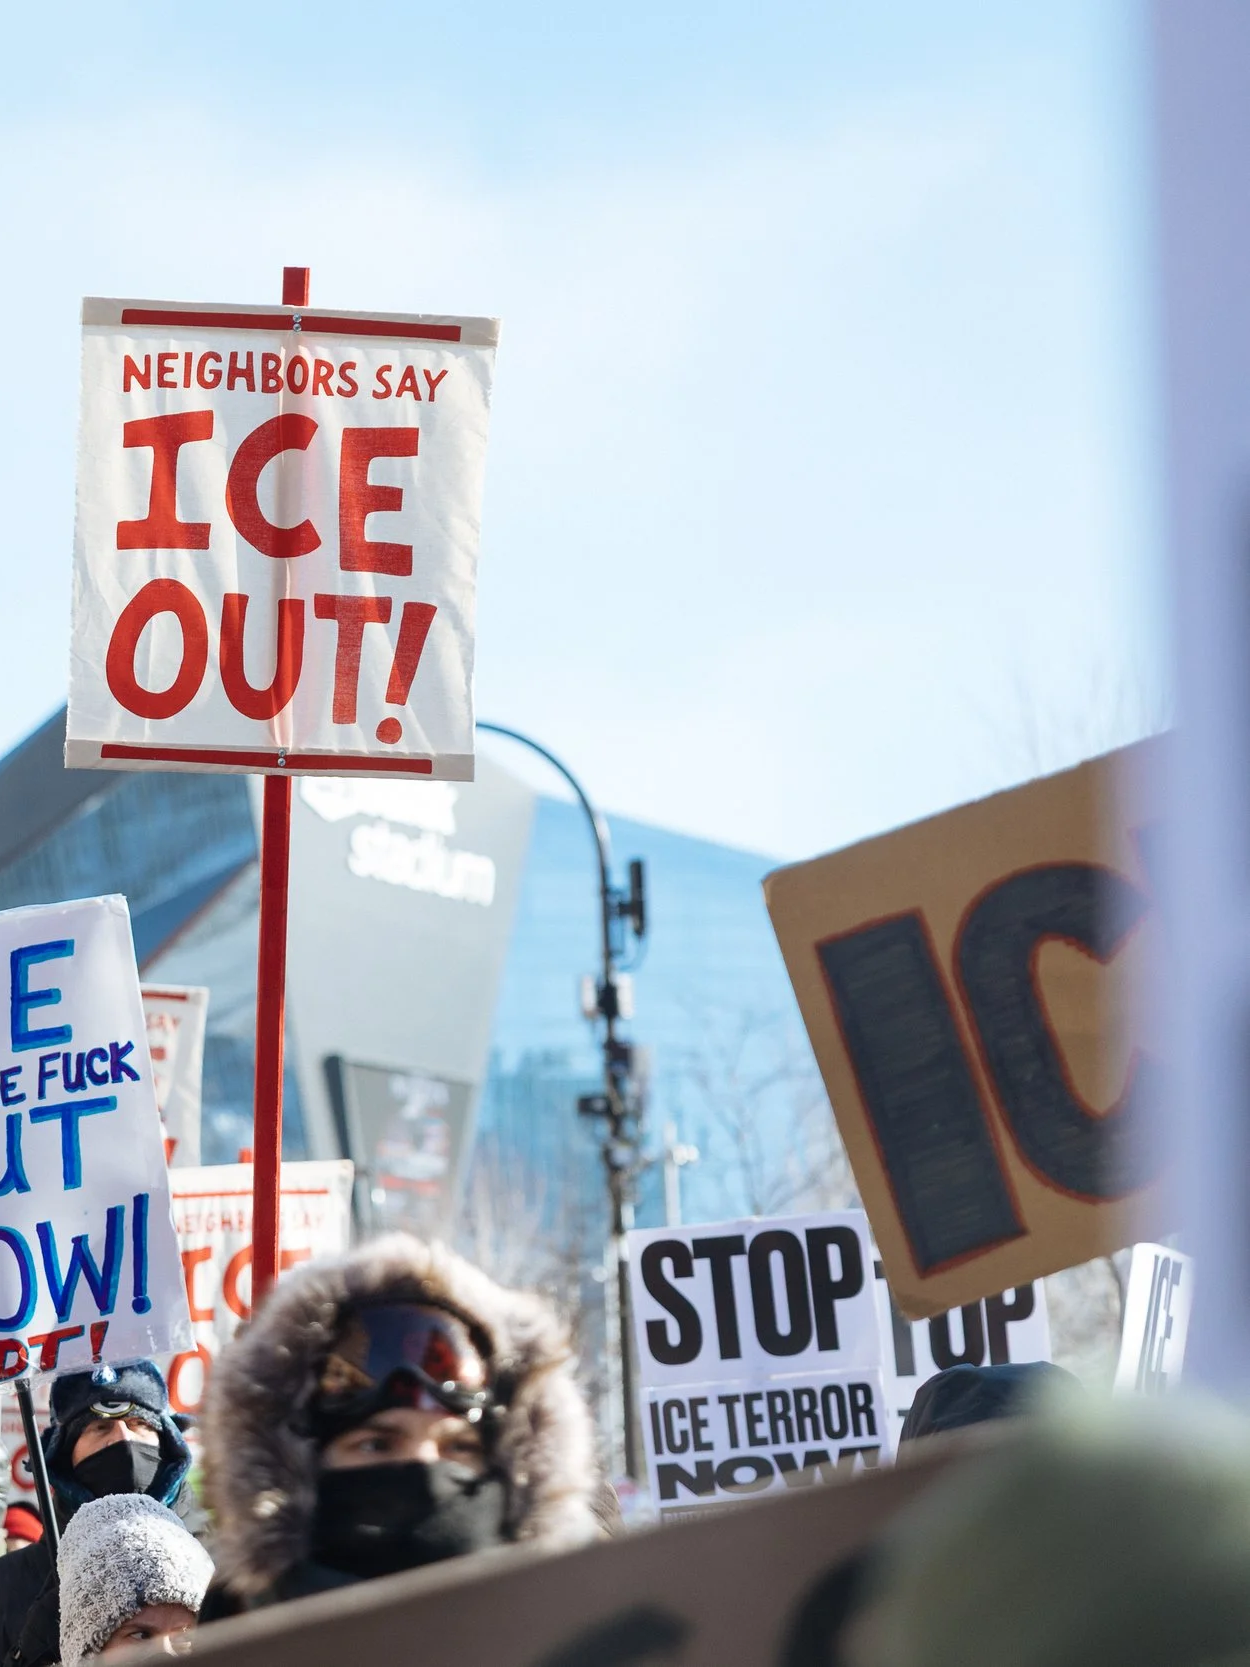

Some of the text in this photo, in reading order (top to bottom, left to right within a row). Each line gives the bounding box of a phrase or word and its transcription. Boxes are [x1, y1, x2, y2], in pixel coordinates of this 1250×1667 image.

[123, 350, 449, 402] NEIGHBORS SAY
[116, 409, 420, 577] ICE
[105, 577, 438, 745] OUT!
[37, 1040, 141, 1100] FUCK
[814, 859, 1174, 1279] IC
[640, 1226, 864, 1366] STOP
[650, 1382, 877, 1455] ICE TERROR
